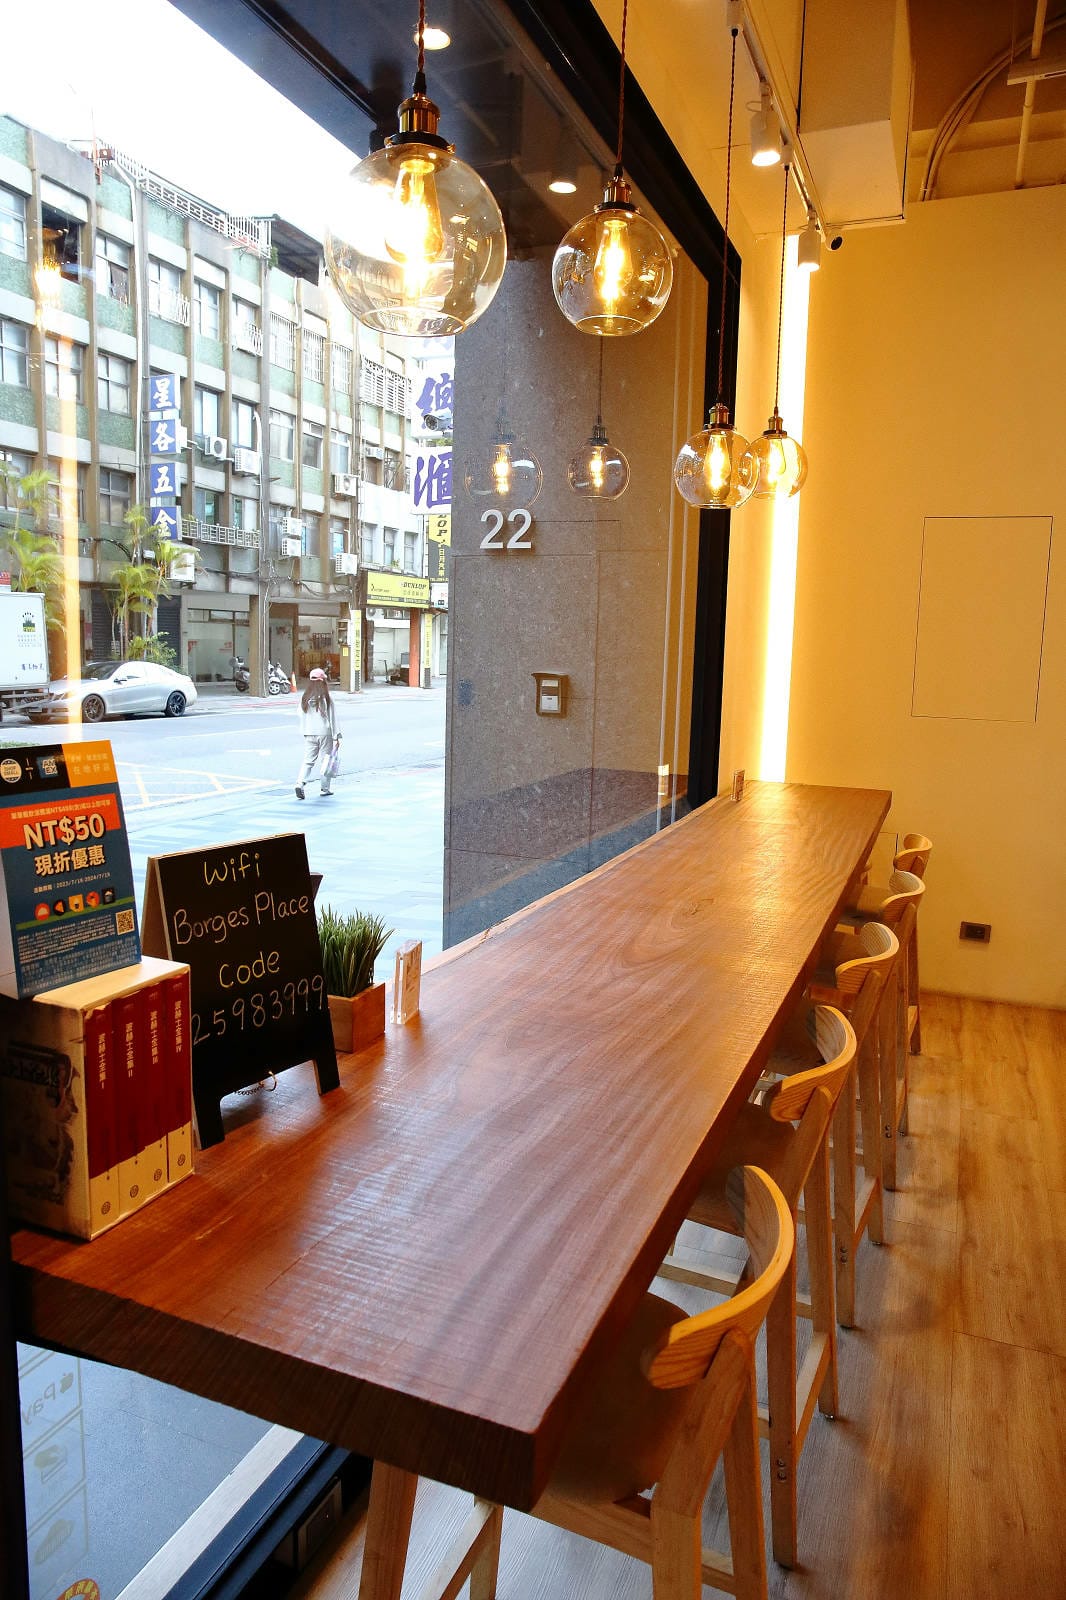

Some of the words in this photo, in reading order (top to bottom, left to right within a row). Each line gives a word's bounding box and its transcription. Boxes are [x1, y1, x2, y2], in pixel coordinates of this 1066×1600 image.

[480, 508, 532, 549] 22
[403, 581, 427, 591] DUNLOP
[23, 813, 105, 850] NT$50
[34, 845, 106, 876] 現折優惠
[173, 907, 249, 945] Borges
[255, 891, 309, 925] Place
[191, 975, 324, 1046] 25983999
